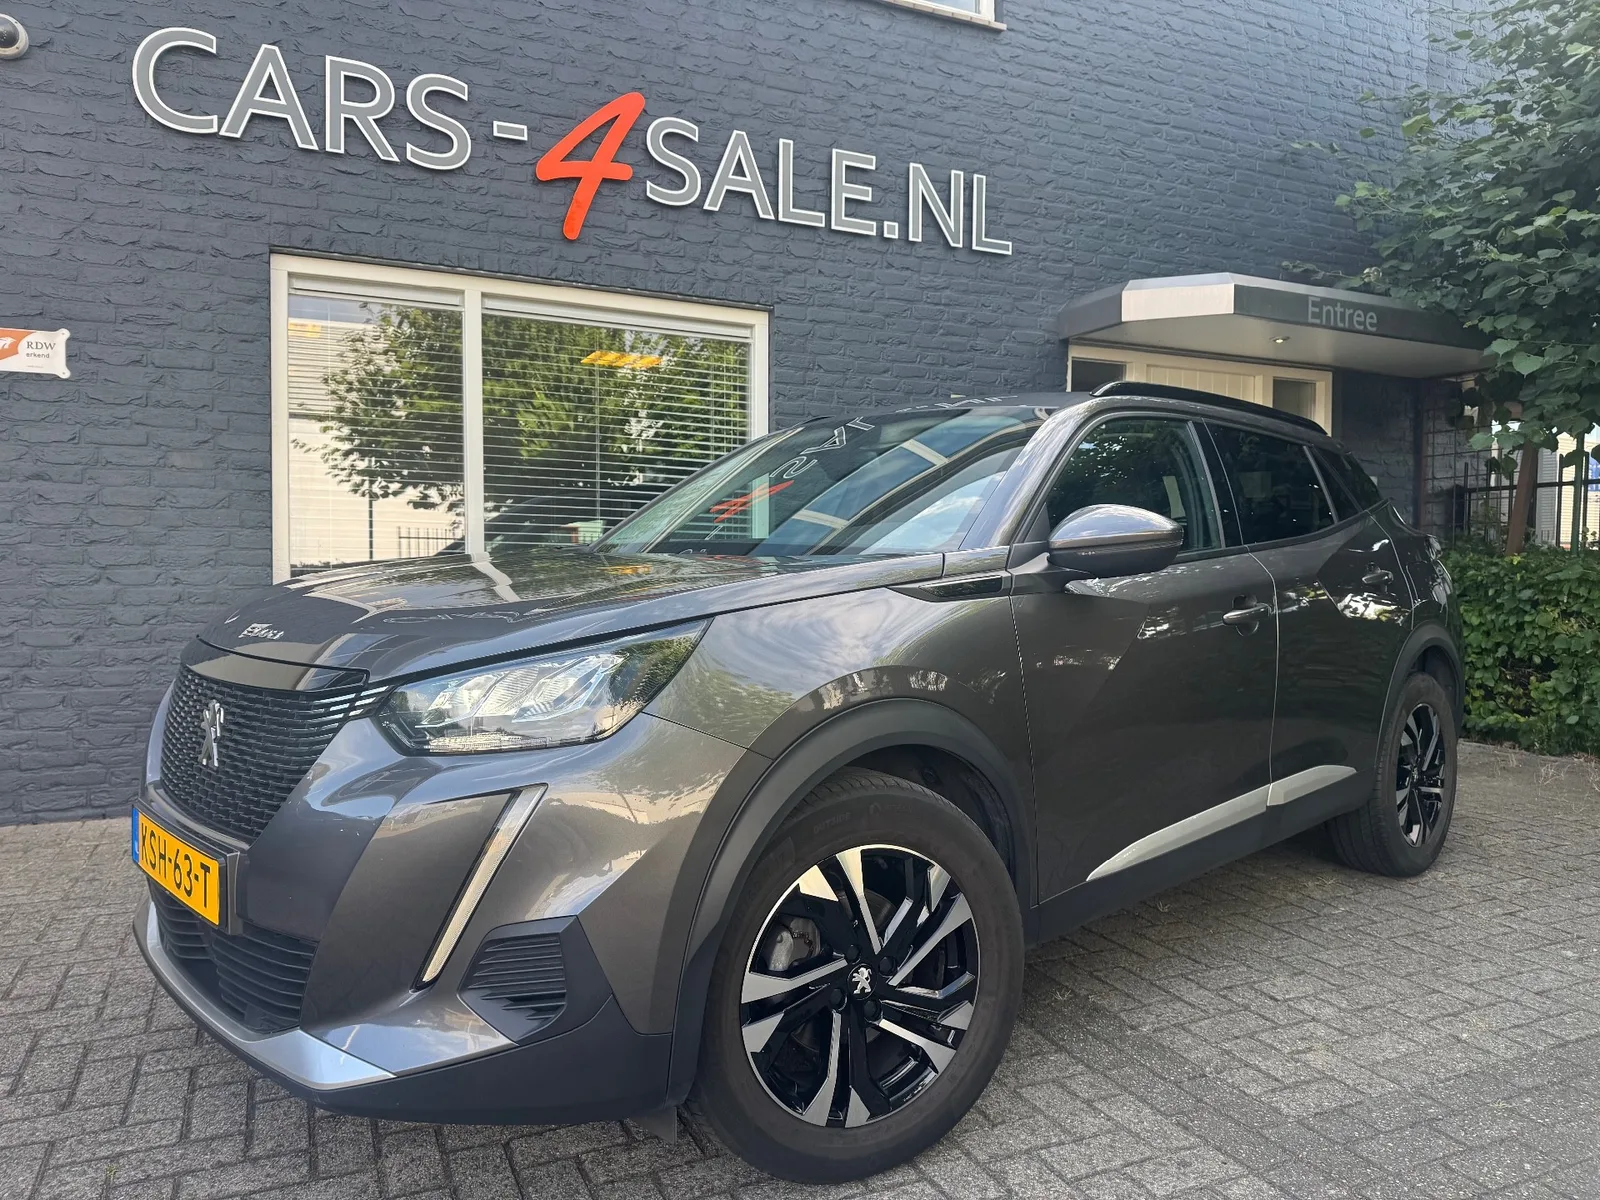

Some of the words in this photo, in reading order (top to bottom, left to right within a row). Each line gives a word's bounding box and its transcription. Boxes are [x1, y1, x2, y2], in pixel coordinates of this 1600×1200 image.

[1308, 296, 1378, 332] Entree
[26, 341, 56, 350] RDW
[141, 822, 211, 909] KSH-63-T
